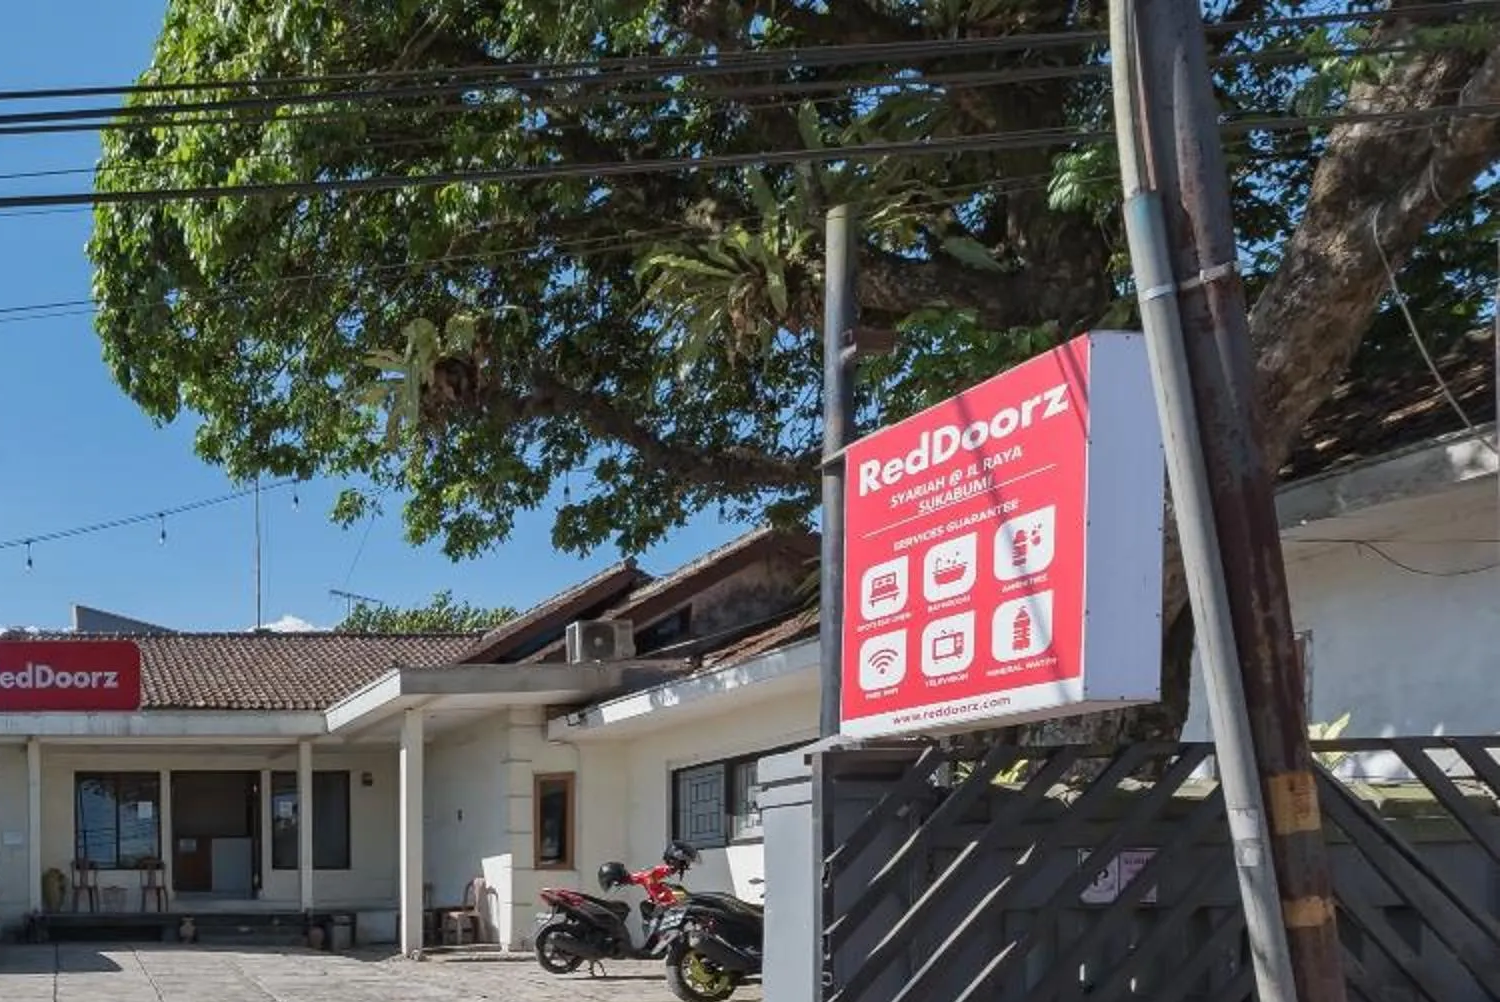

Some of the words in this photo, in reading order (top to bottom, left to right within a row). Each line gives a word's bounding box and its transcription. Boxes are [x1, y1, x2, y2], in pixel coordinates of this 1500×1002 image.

[859, 383, 1070, 497] RedDoorz
[889, 475, 946, 509] SYARIAH
[949, 469, 963, 486] @
[983, 445, 1023, 471] RAYA
[917, 475, 993, 514] SUKABUMI
[893, 697, 1011, 725] www.reddoorz.com
